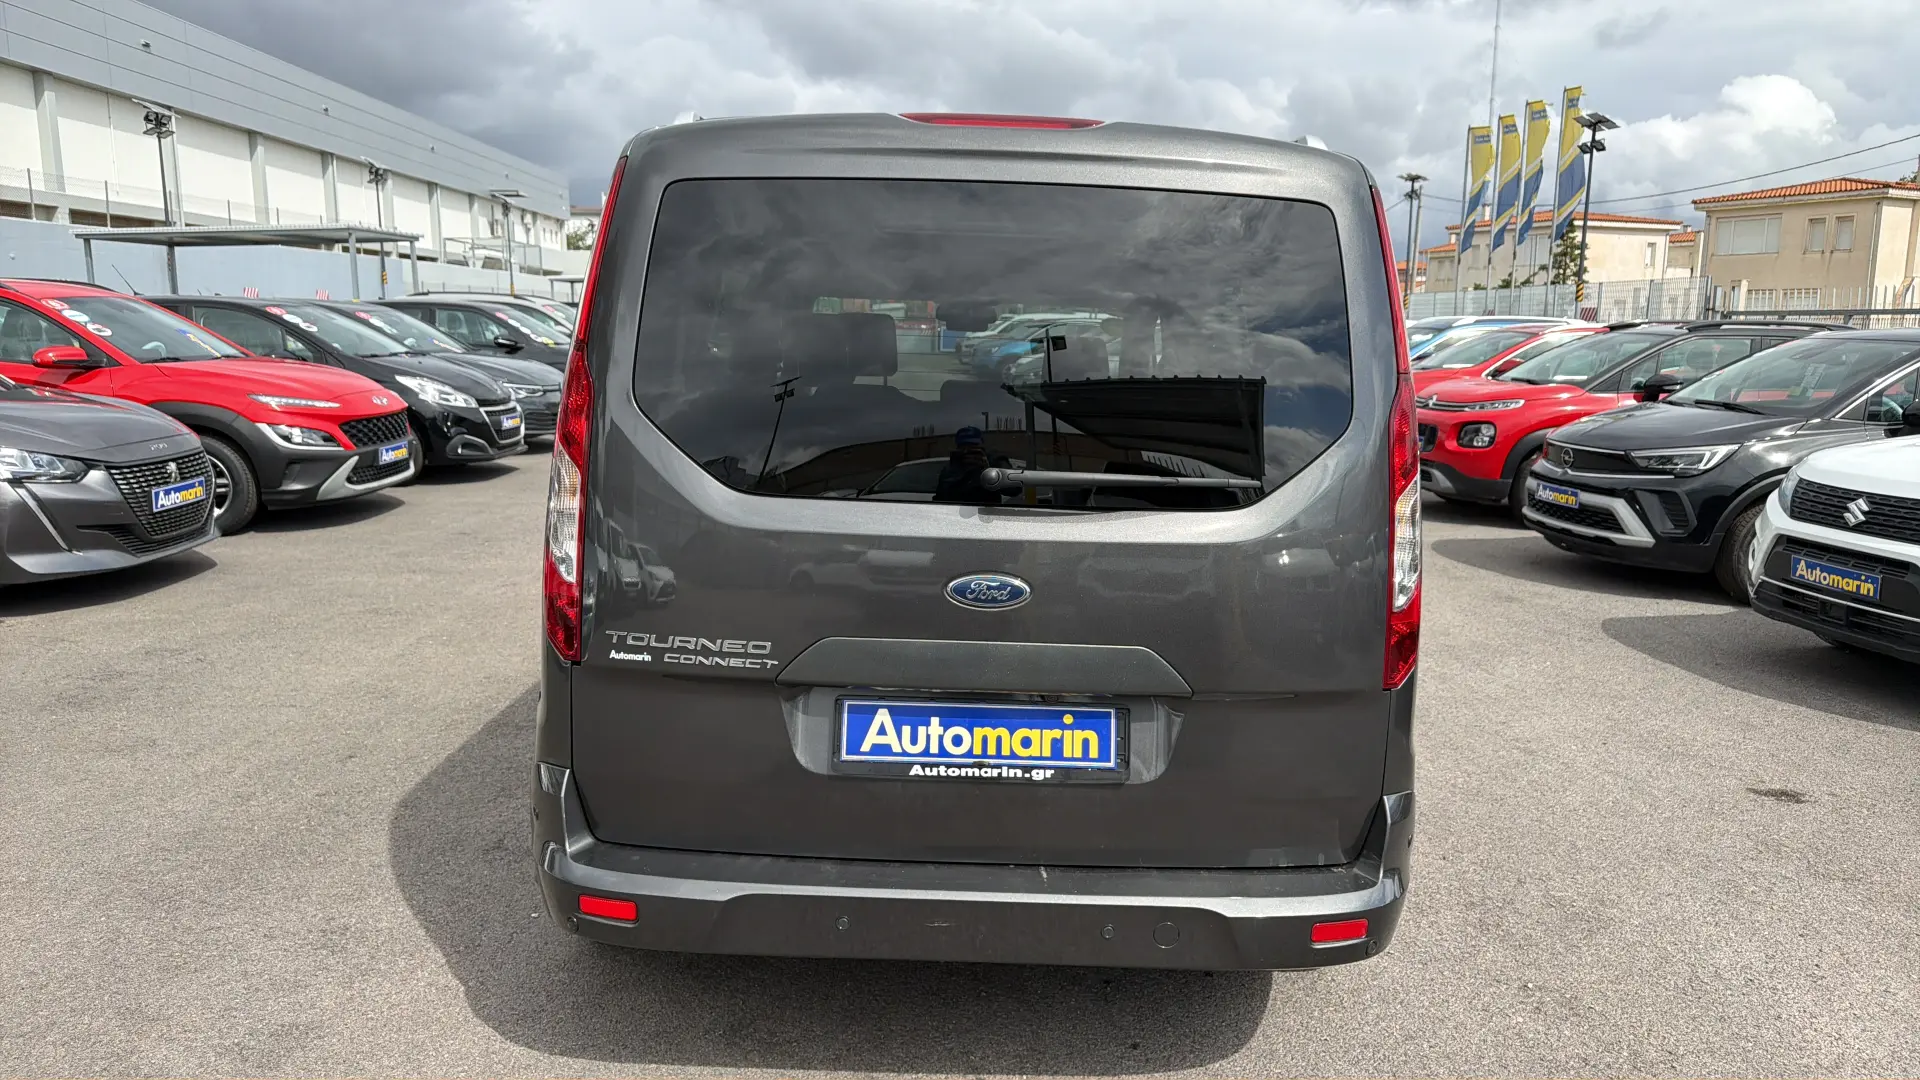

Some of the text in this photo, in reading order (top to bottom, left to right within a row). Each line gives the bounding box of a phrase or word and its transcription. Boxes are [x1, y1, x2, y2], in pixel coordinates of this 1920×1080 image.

[157, 482, 203, 508] Automarin
[1537, 484, 1576, 506] Automarin
[1795, 559, 1874, 597] Automarin
[965, 580, 1012, 601] Ford
[605, 630, 772, 655] TOURNEO
[609, 649, 652, 662] Automarin
[663, 653, 779, 669] CONNECT
[860, 708, 1099, 759] Automarin
[909, 764, 1055, 781] Automarin.gr
